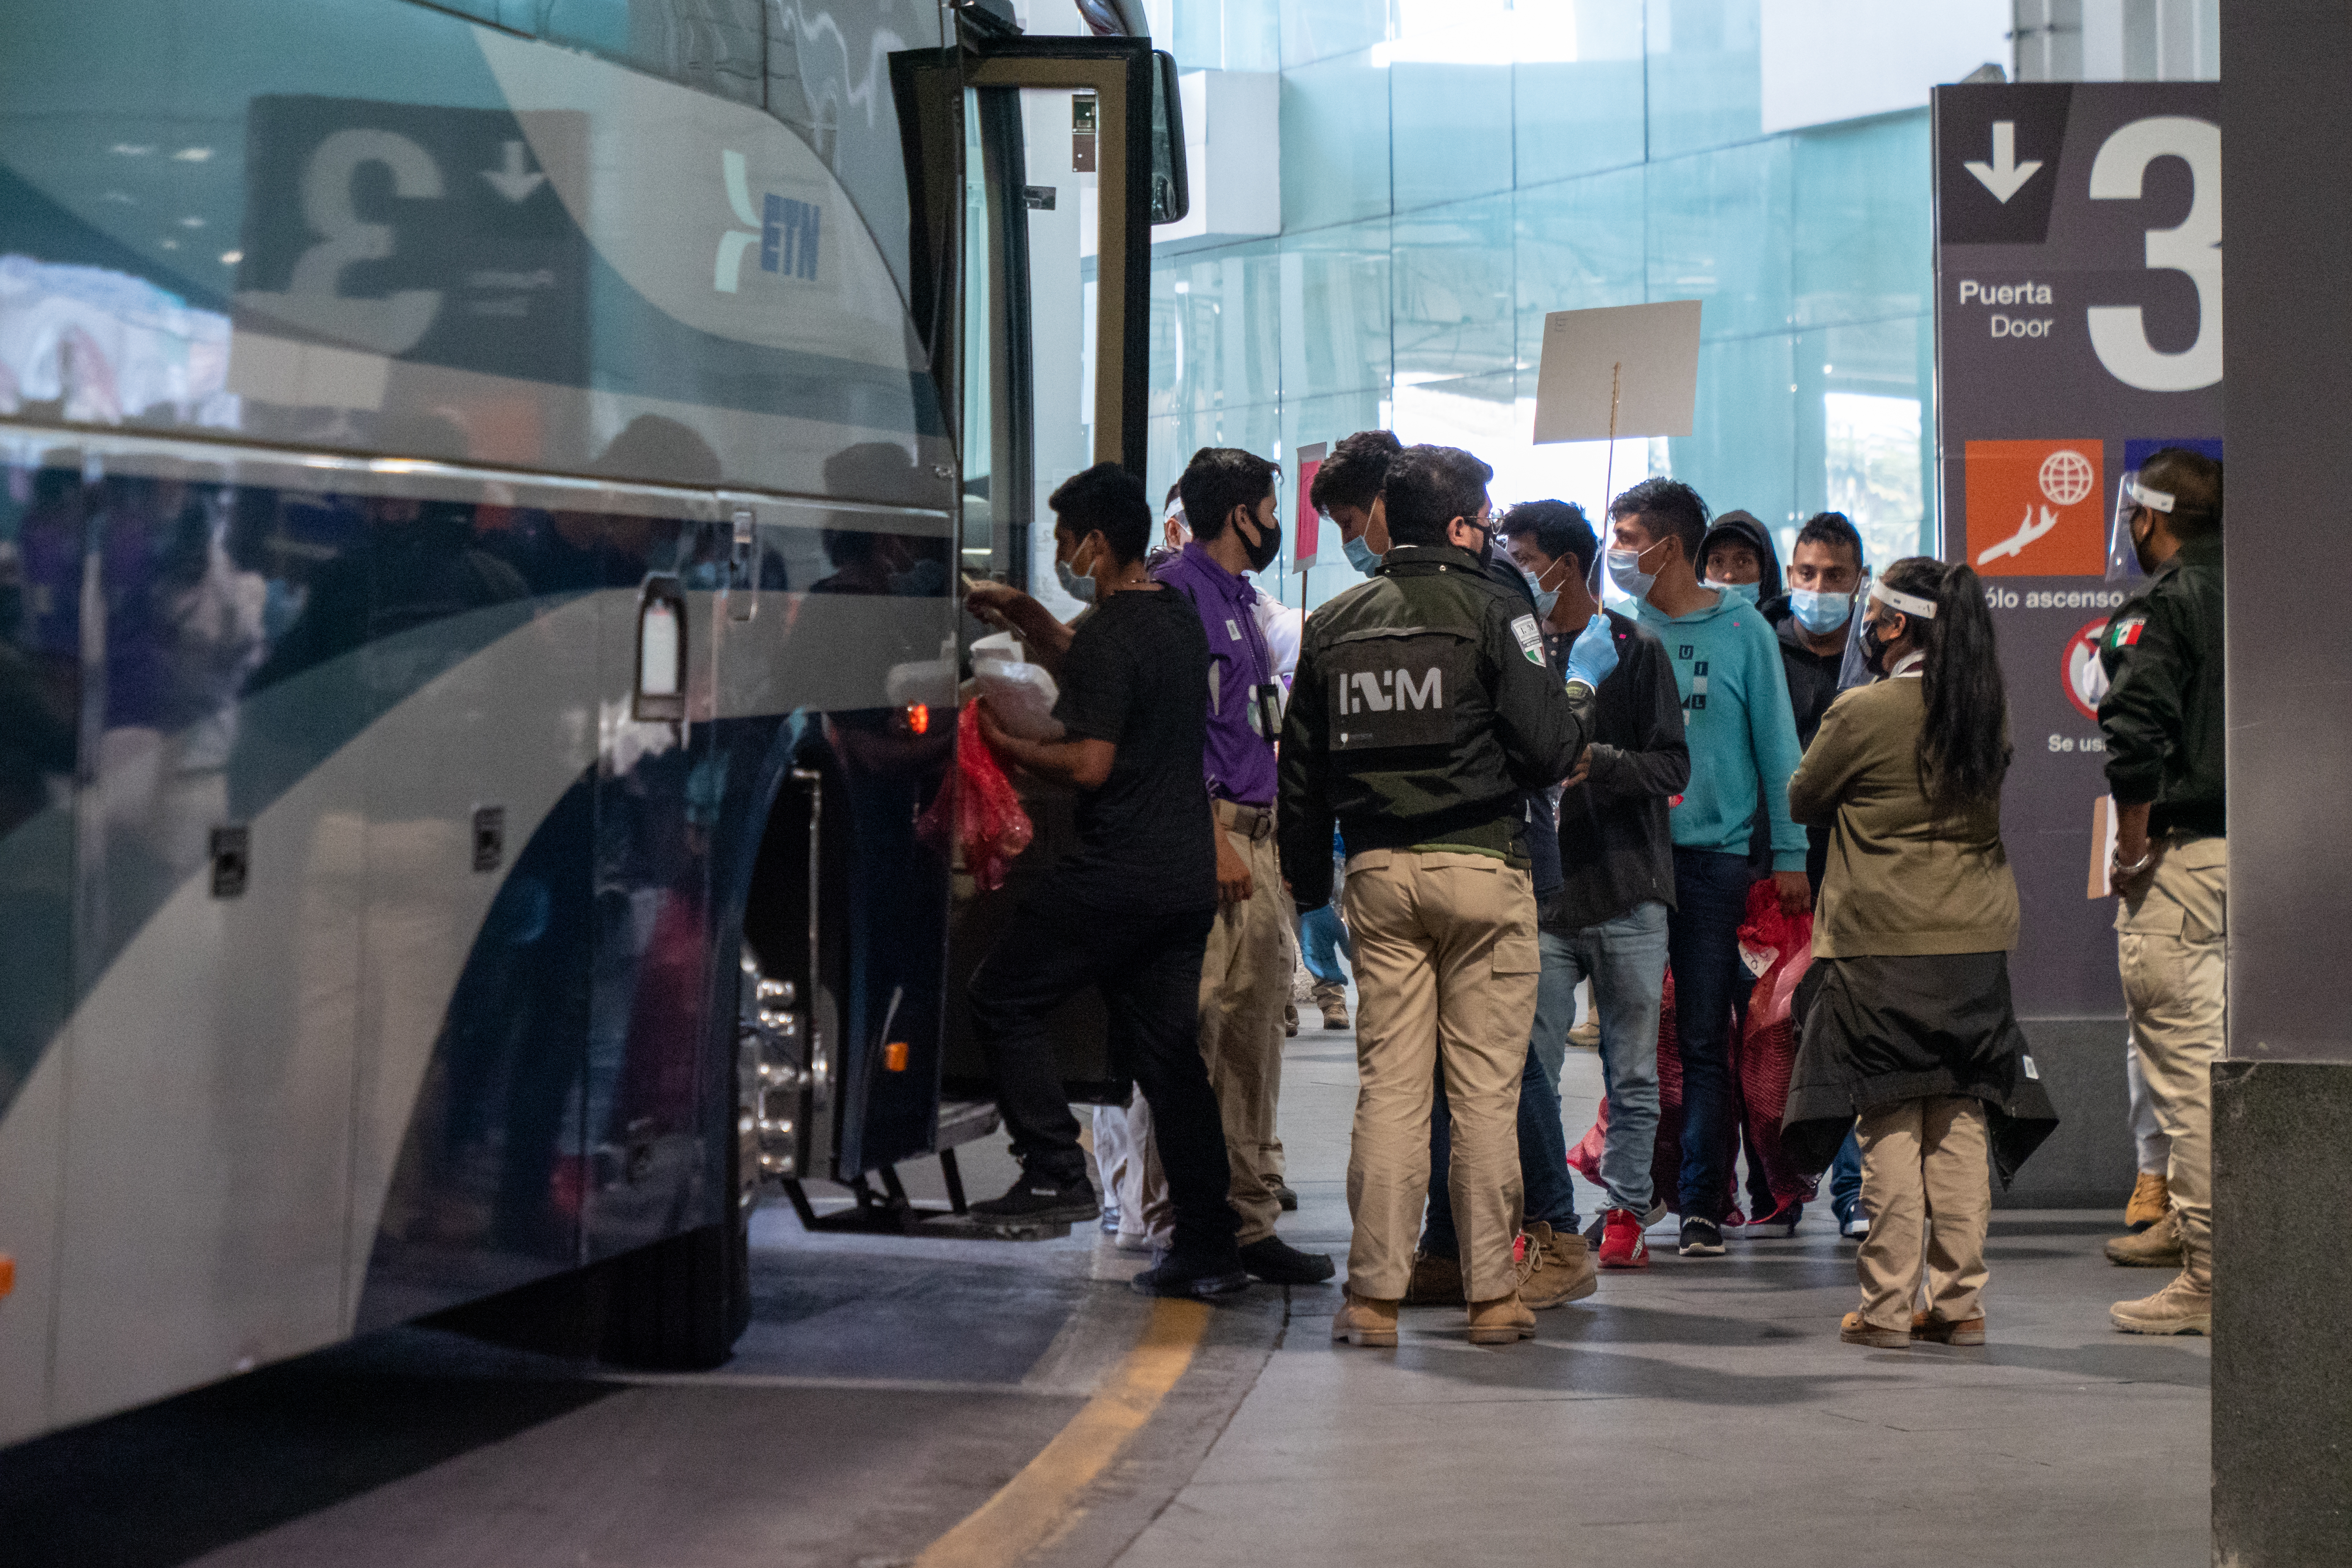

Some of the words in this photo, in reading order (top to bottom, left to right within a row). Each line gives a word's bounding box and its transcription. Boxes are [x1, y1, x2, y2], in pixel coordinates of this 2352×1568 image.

[2087, 115, 2223, 392] 3
[1960, 280, 2052, 305] Puerta
[1991, 315, 2053, 338] Door
[1985, 586, 2019, 608] ólo
[2025, 591, 2124, 608] ascenso
[2048, 734, 2073, 752] Se
[2079, 737, 2106, 752] us
